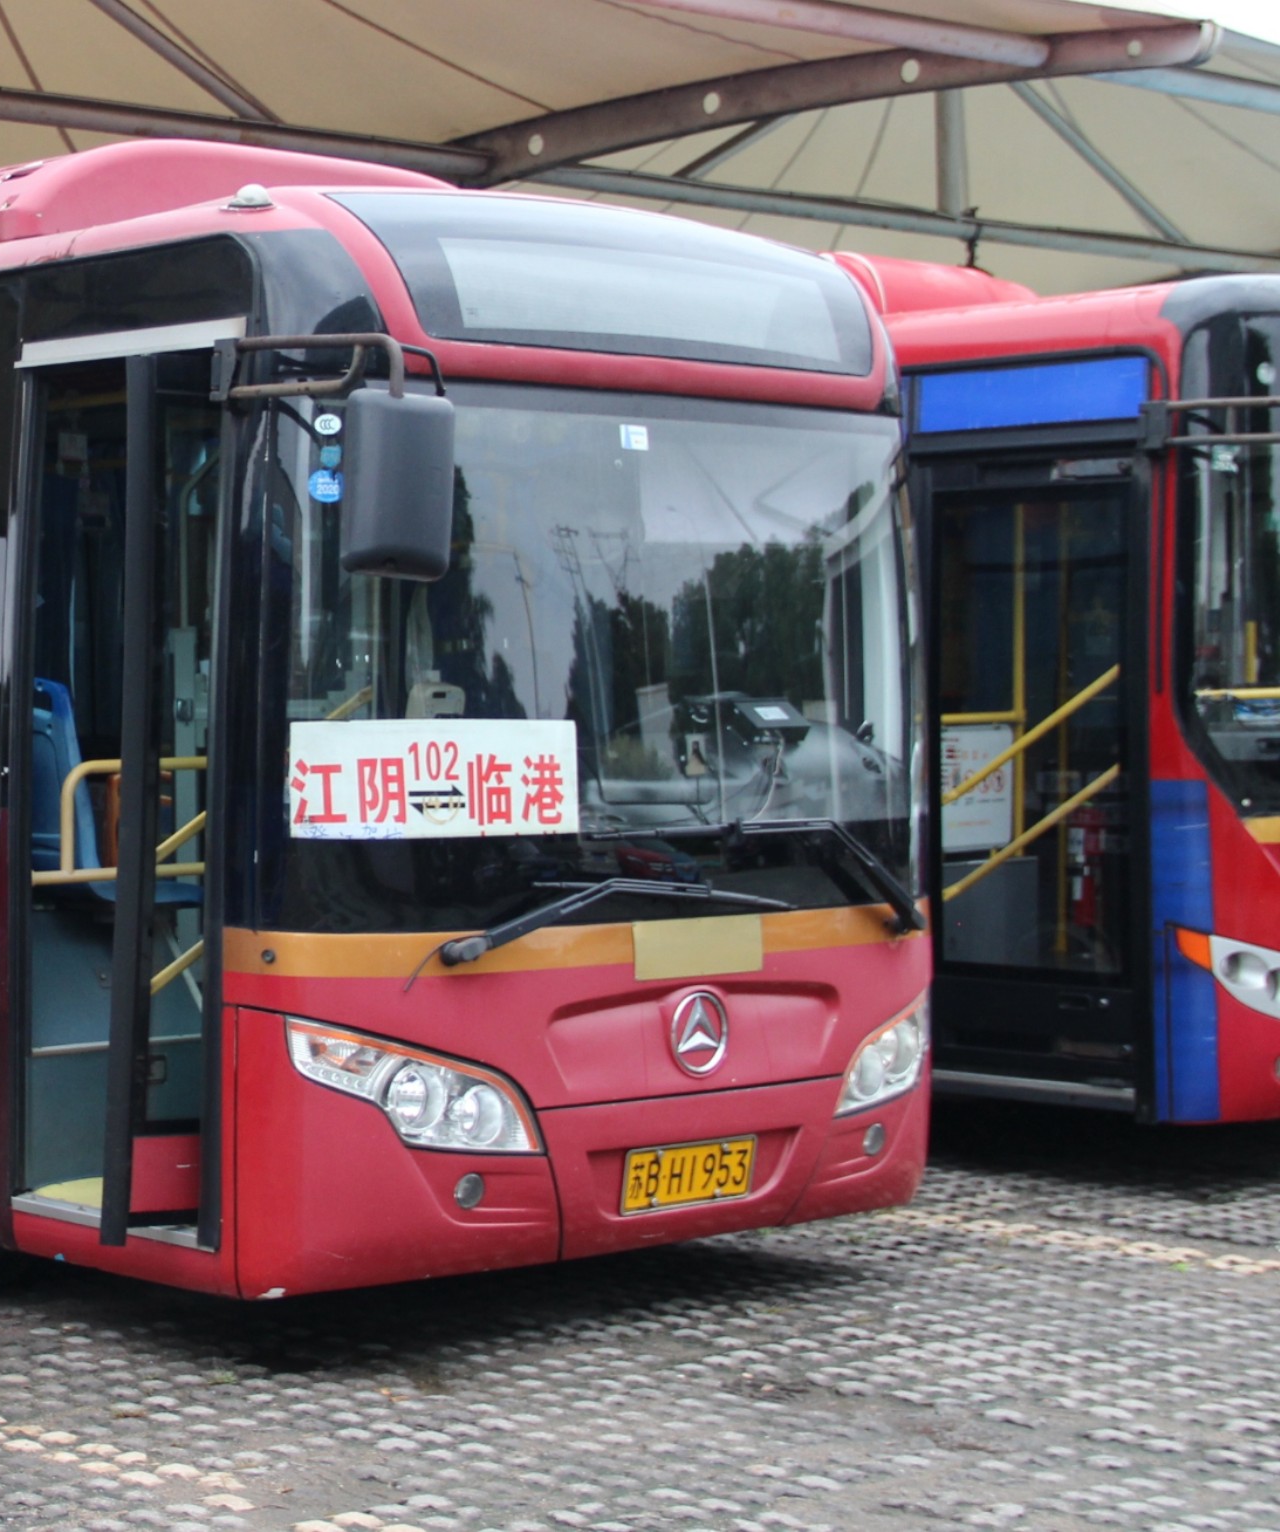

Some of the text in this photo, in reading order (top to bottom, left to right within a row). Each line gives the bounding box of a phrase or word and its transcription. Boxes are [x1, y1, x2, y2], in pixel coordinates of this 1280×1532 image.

[408, 741, 460, 781] 102
[290, 753, 564, 826] 江阴 临港
